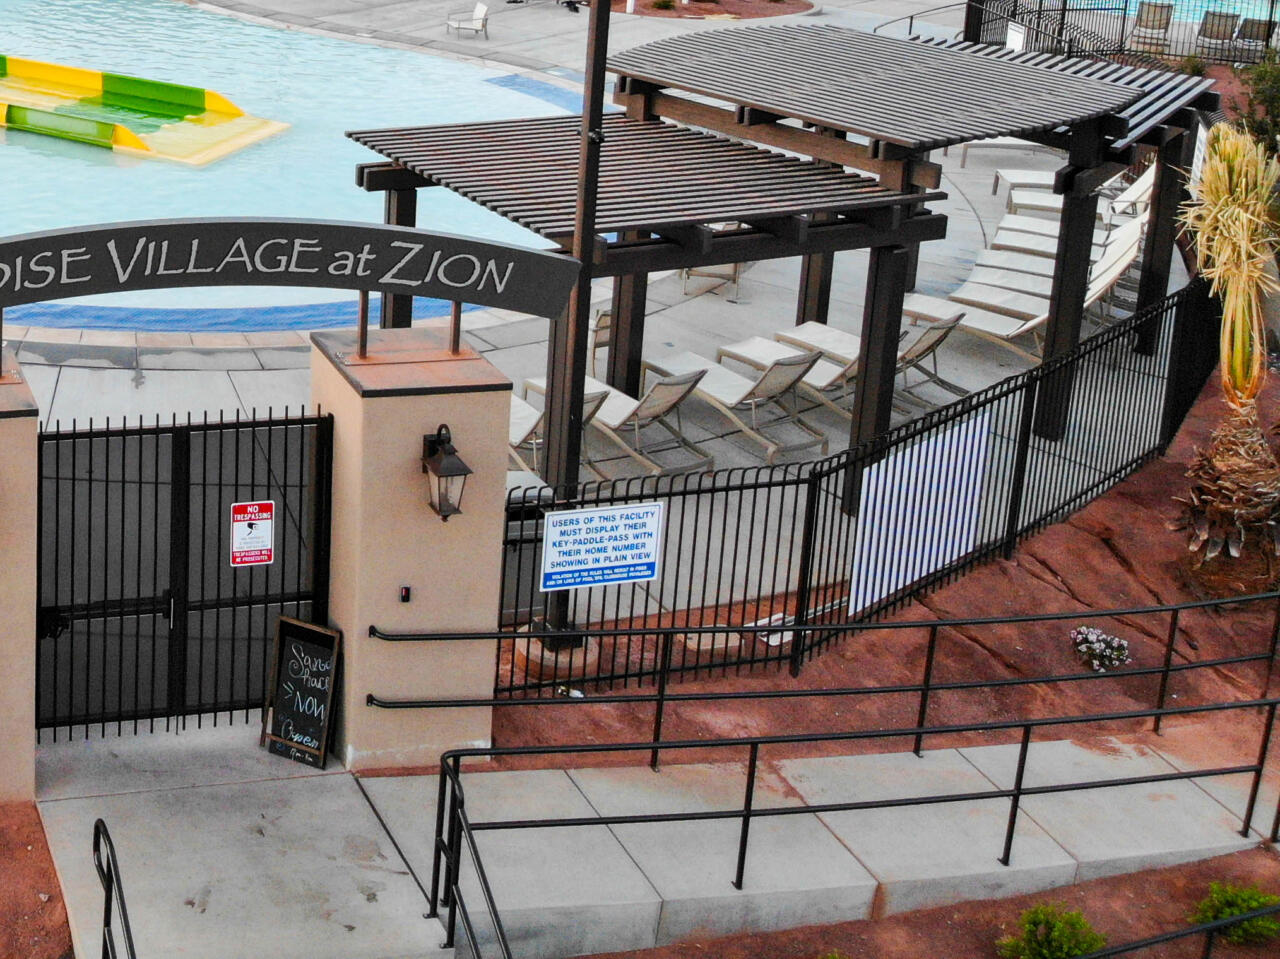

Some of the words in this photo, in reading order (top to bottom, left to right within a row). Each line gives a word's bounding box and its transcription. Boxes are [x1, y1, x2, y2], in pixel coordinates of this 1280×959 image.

[106, 236, 323, 284] VILLAGE
[327, 243, 377, 277] at
[378, 240, 515, 294] ZION
[234, 512, 271, 521] TRESPASSING
[247, 505, 259, 513] NO
[552, 518, 580, 528] USERS
[583, 516, 595, 525] OF
[598, 514, 616, 523] THIS
[620, 511, 656, 521] FACILITY
[559, 528, 582, 537] MUST
[585, 524, 619, 534] DISPLAY
[623, 521, 647, 531] THEIR
[552, 534, 629, 548] KEY-PADDLE-PASS
[632, 531, 653, 540] WITH
[557, 548, 581, 558] THEIR
[585, 546, 608, 555] HOME
[611, 542, 646, 553] NUMBER
[550, 558, 589, 569] SHOWING
[592, 557, 600, 565] IN
[603, 554, 628, 563] PLAIN
[630, 551, 651, 560] VIEW
